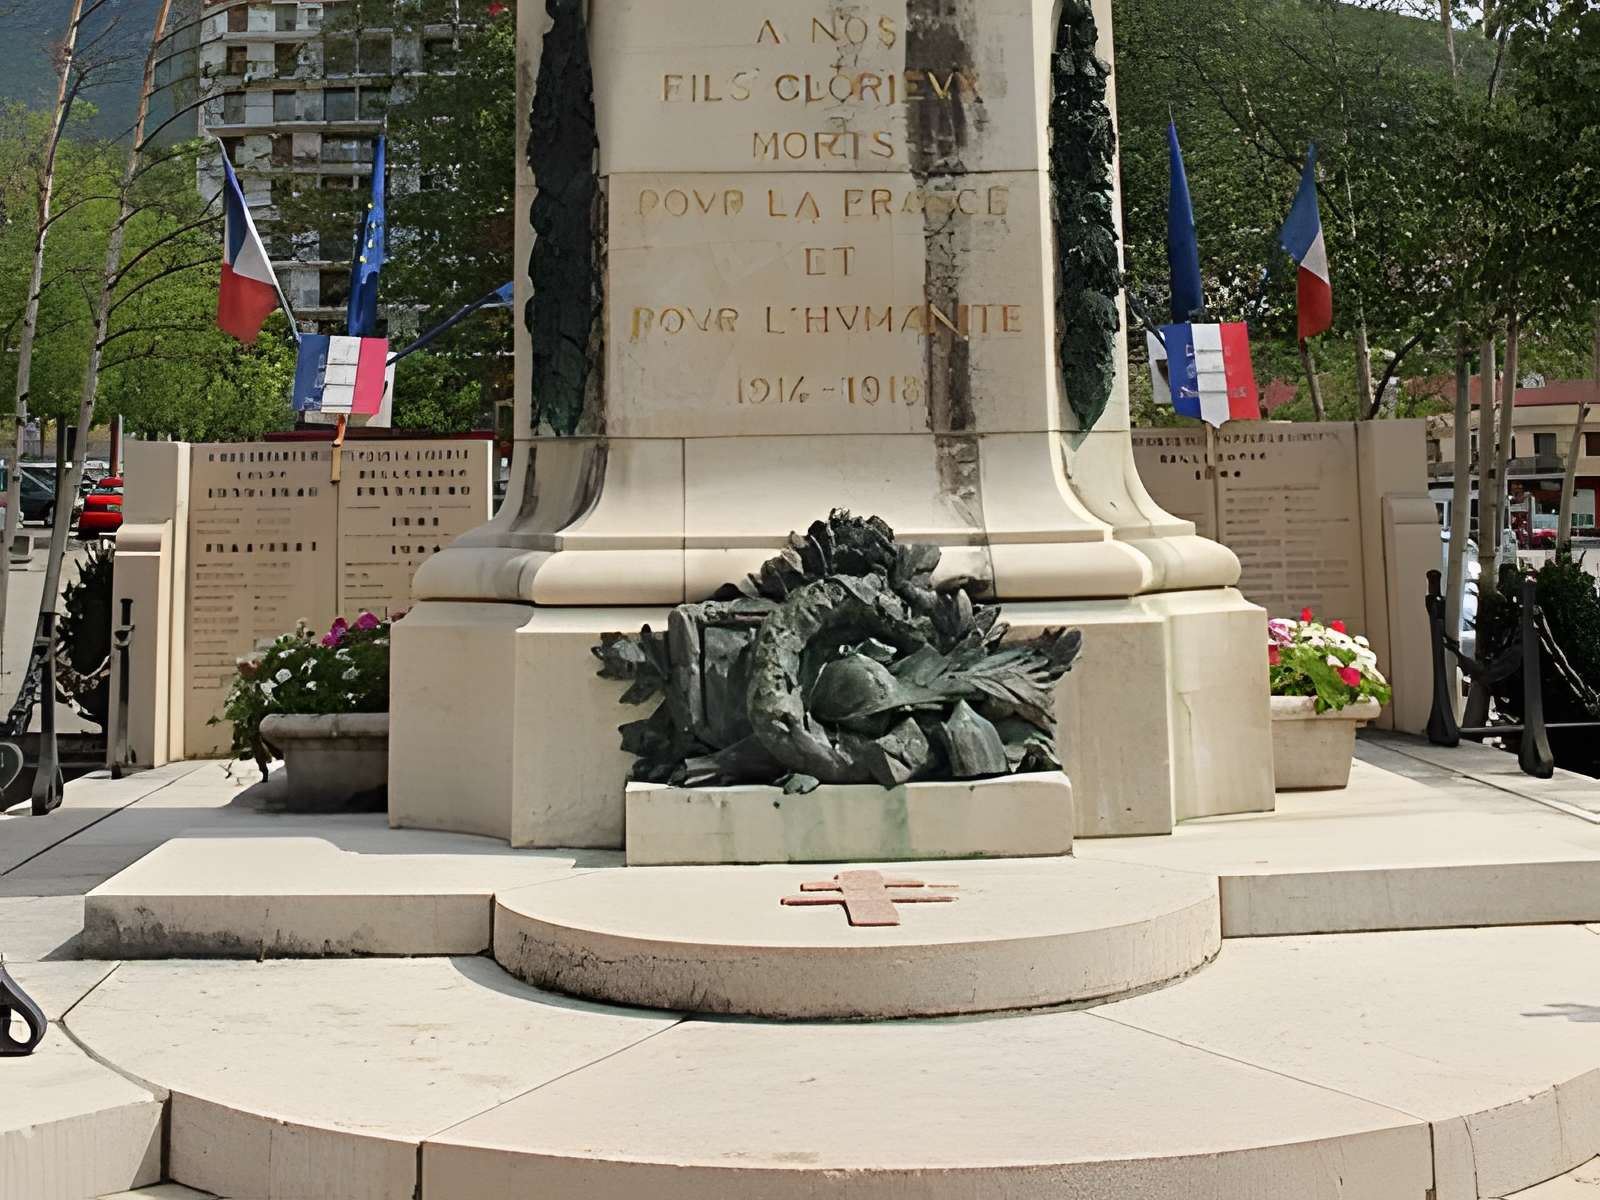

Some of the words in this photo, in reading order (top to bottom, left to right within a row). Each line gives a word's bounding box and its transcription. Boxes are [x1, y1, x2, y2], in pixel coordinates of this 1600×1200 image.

[756, 18, 780, 44] A
[811, 16, 897, 49] NOS
[663, 72, 751, 103] FILS
[752, 131, 896, 161] MORTS
[638, 188, 744, 216] POVR
[767, 188, 821, 218] LA
[843, 186, 1010, 217] FRACE
[805, 245, 856, 277] ET
[632, 306, 740, 338] POVR
